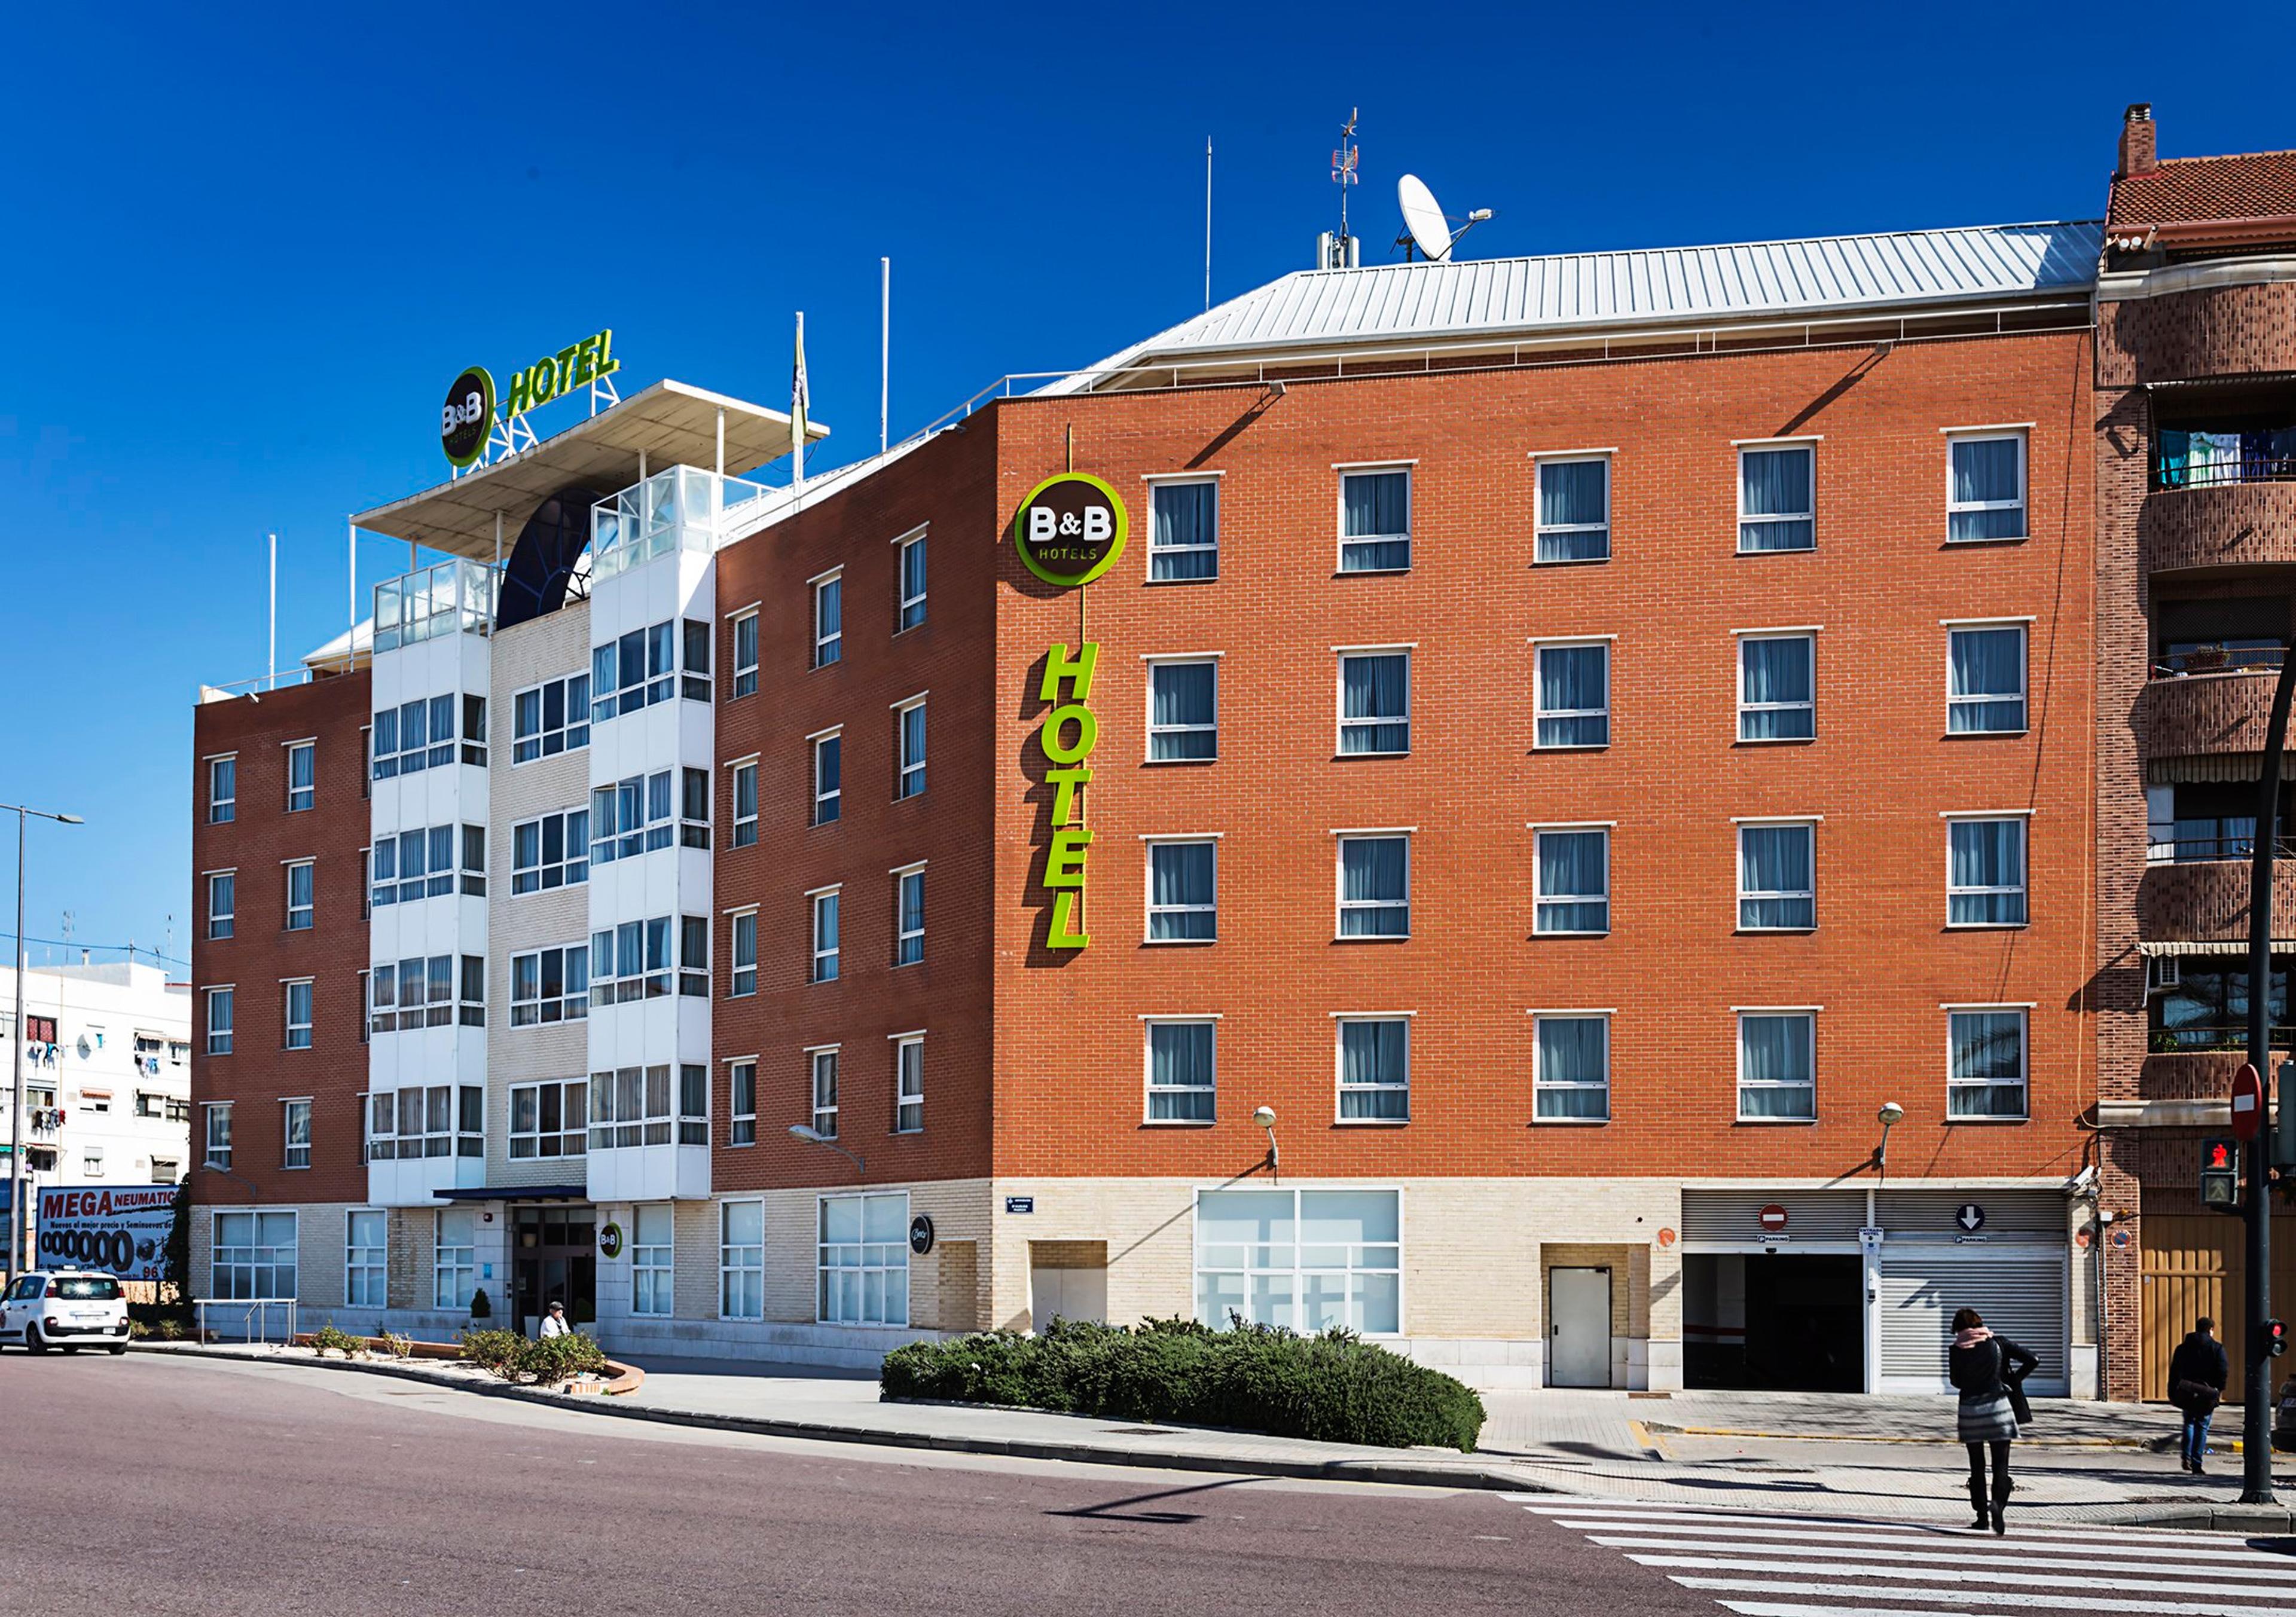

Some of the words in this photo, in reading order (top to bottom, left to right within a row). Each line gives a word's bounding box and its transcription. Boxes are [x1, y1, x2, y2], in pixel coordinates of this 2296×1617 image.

[507, 328, 620, 419] HOTEL
[442, 391, 482, 436] B&B
[1029, 506, 1112, 542] B&B
[1039, 548, 1097, 560] HOTELS
[1039, 642, 1099, 949] HOTEL
[44, 1191, 112, 1218] MEGA
[114, 1191, 176, 1206] NEUMATIC
[81, 1221, 99, 1230] mejor
[100, 1221, 119, 1230] precio
[601, 1234, 616, 1245] B&B
